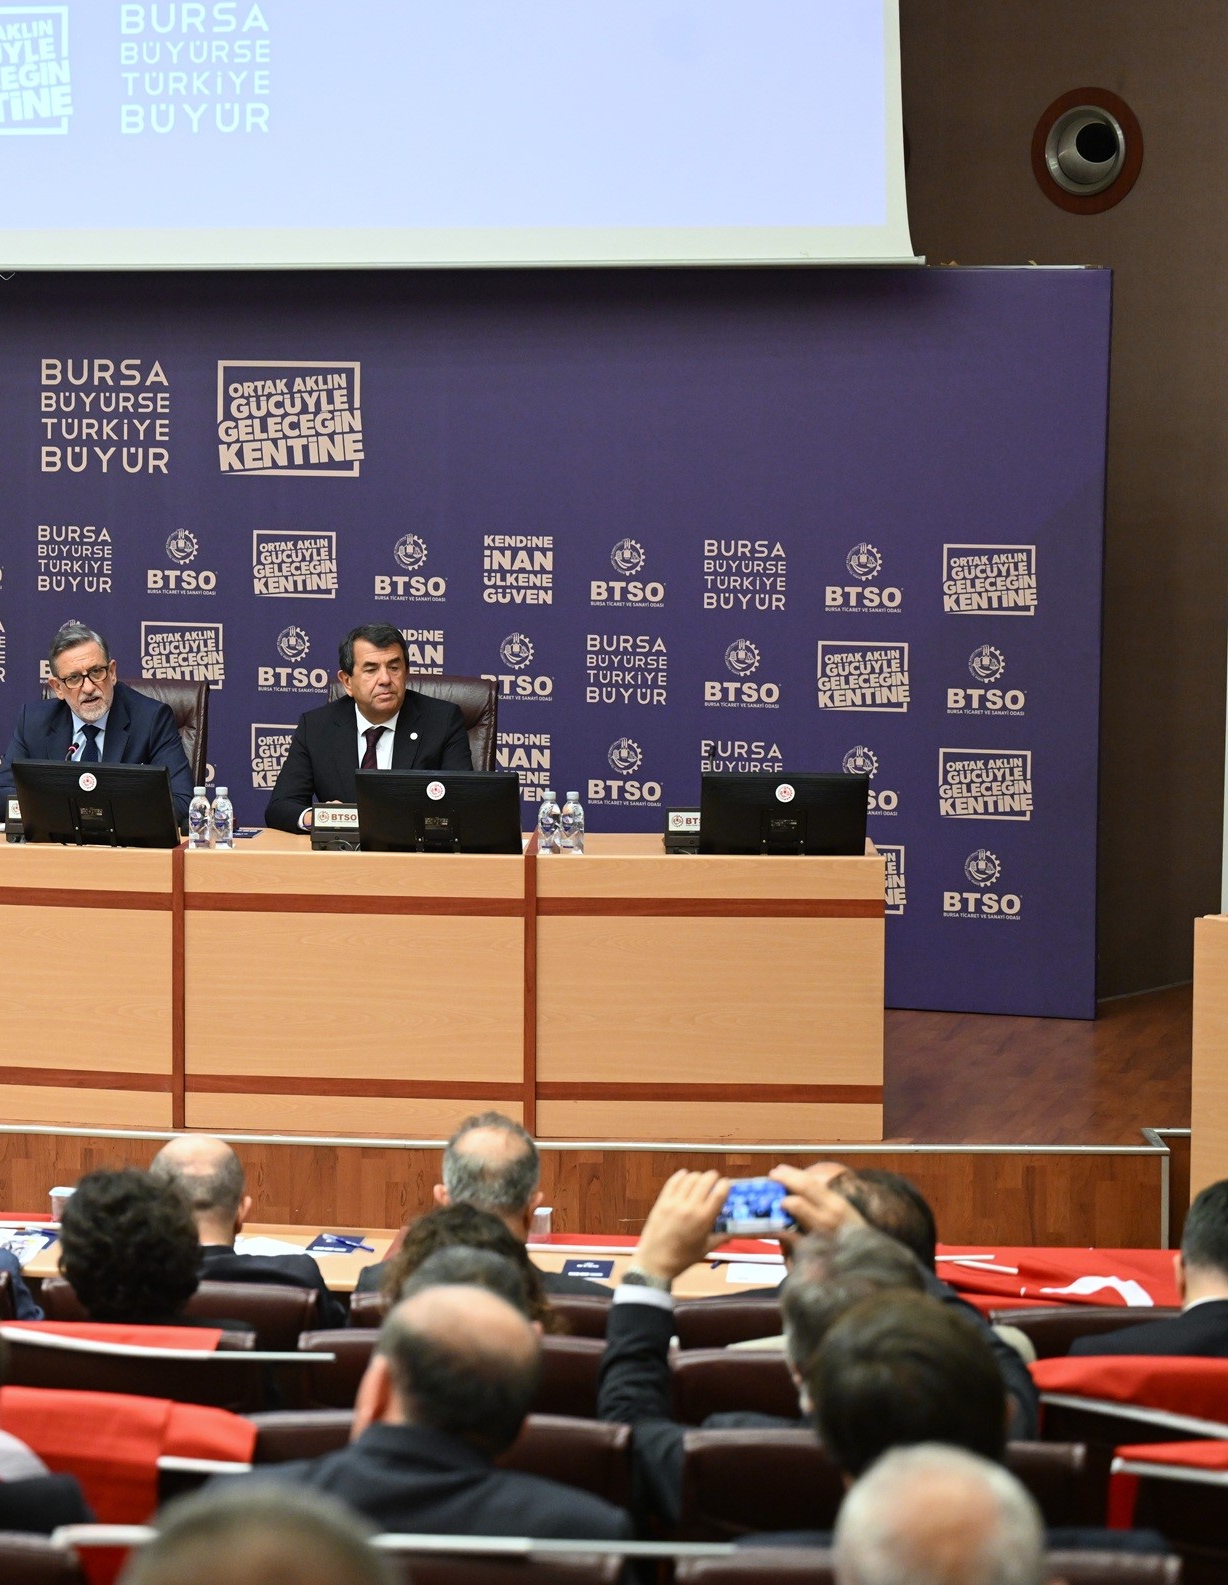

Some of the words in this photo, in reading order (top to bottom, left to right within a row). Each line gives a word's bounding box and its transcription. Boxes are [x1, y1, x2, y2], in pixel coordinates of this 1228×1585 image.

[122, 2, 269, 34] BURSA
[121, 40, 270, 64] BÜYÜRSE
[122, 71, 270, 96] TÜRKİYE
[122, 103, 269, 134] BÜYÜR
[42, 359, 169, 386] BURSA
[229, 379, 288, 398] ORTAK
[293, 373, 347, 392] AKLIN
[42, 392, 170, 413] BÜYÜRSE
[231, 389, 349, 419] GÜCÜYLE
[42, 419, 169, 441] TÜRKİYE
[42, 446, 169, 474] BÜYÜR
[38, 526, 111, 542] BURSA
[38, 545, 112, 558] BÜYÜRSE
[260, 541, 294, 552] ORTAK
[297, 539, 328, 549] AKLIN
[705, 540, 786, 557] BURSA
[38, 560, 112, 574] TÜRKİYE
[704, 560, 786, 574] BÜYÜRSE
[951, 556, 989, 567] ORTAK
[992, 553, 1027, 564] AKLIN
[38, 576, 112, 593] BÜYÜR
[148, 570, 216, 590] BTSO
[375, 576, 446, 596] BTSO
[484, 573, 553, 587] ÜLKENE
[704, 576, 786, 590] TÜRKİYE
[484, 588, 552, 604] GÜVEN
[591, 581, 664, 602] BTSO
[826, 586, 902, 607] BTSO
[704, 593, 785, 610] BÜYÜR
[148, 633, 182, 643] ORTAK
[184, 630, 215, 640] AKLIN
[587, 635, 667, 653] BURSA
[587, 655, 667, 669] BÜYÜRSE
[825, 653, 863, 663] ORTAK
[866, 650, 900, 661] AKLIN
[258, 667, 328, 688] BTSO
[587, 670, 667, 685] TÜRKİYE
[587, 687, 666, 705] BÜYÜR
[705, 682, 779, 703] BTSO
[948, 688, 1025, 710] BTSO
[258, 735, 292, 746] ORTAK
[946, 760, 985, 771] ORTAK
[988, 758, 1022, 769] AKLIN
[588, 780, 661, 801] BTSO
[944, 892, 1021, 914] BTSO
